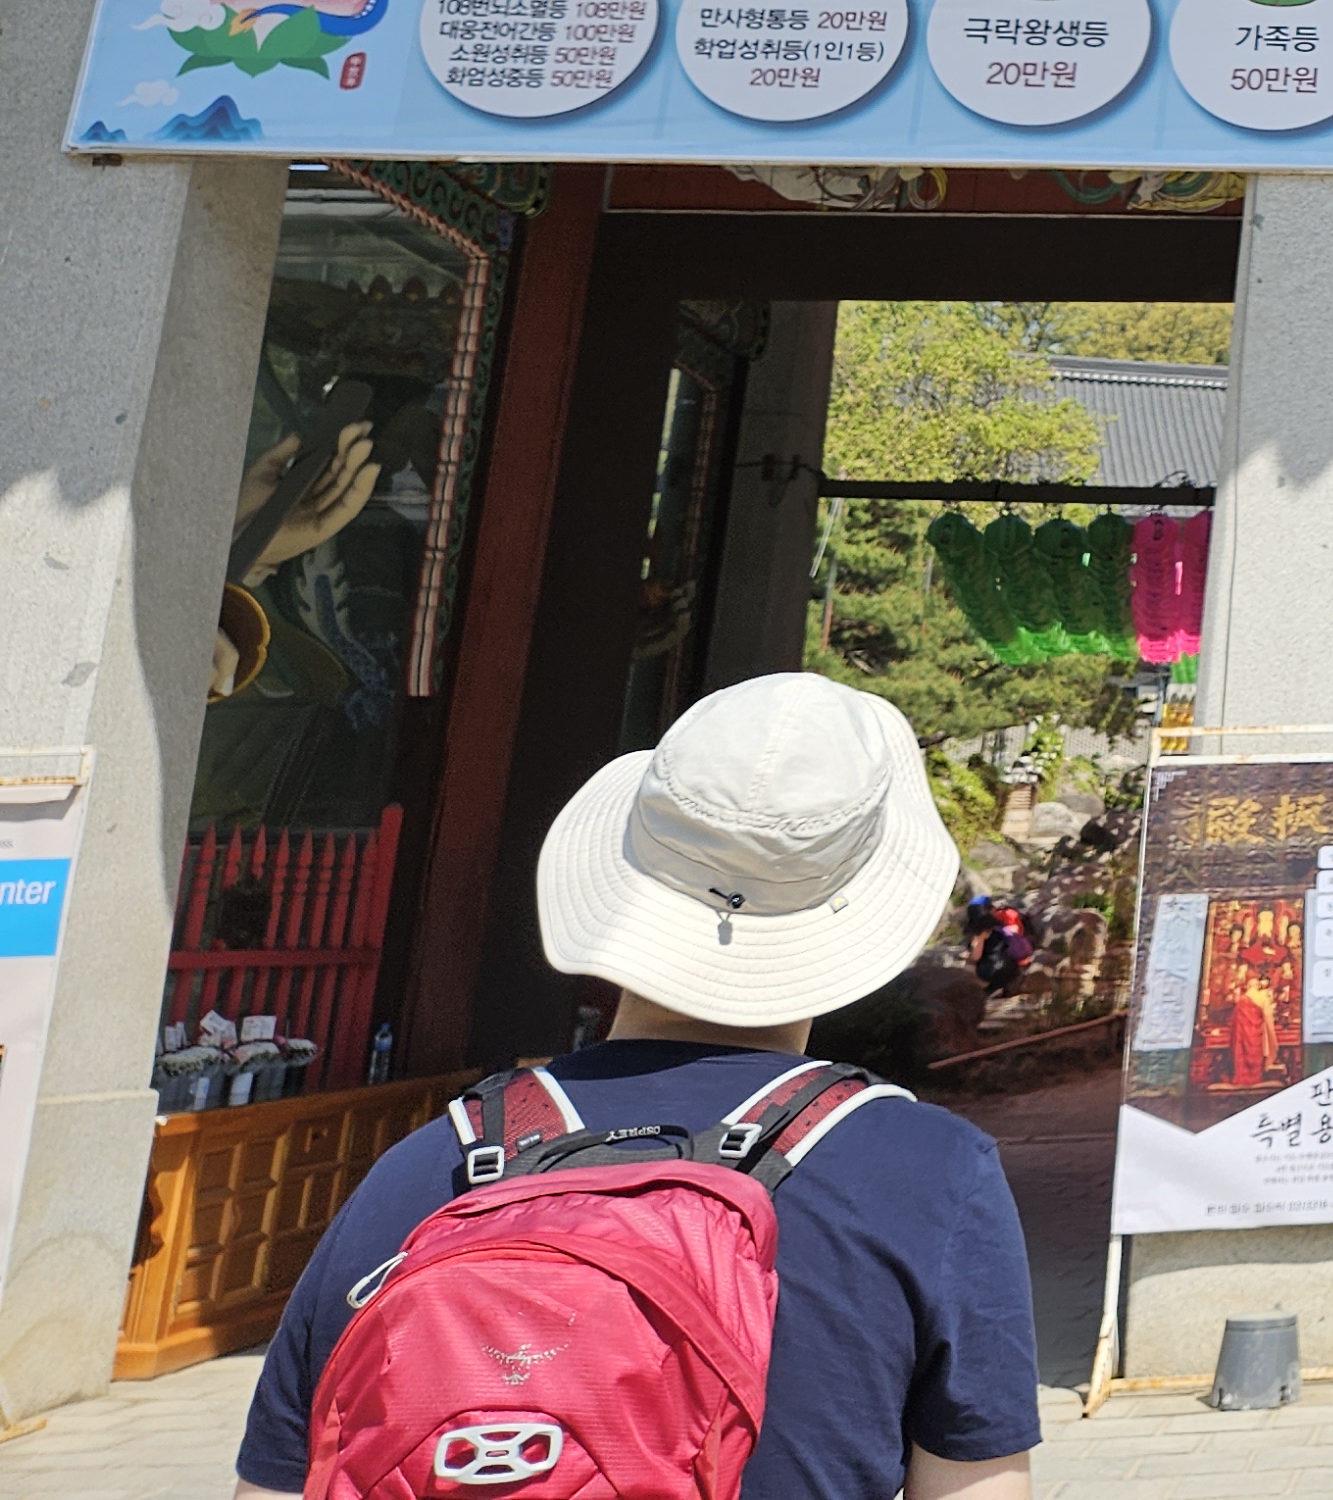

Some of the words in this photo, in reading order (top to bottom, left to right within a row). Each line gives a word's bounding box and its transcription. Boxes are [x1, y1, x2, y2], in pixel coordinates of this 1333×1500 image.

[576, 1, 648, 20] 108만원
[701, 8, 809, 30] 만사형통등
[817, 11, 887, 32] 20만원
[439, 20, 557, 42] 대웅전어간등
[565, 23, 637, 43] 100만원
[964, 18, 1108, 48] 극락왕생등
[1236, 24, 1319, 53] 가족등
[449, 43, 549, 65] 소원성취등
[555, 46, 616, 66] 50만원
[694, 38, 884, 61] 학업성취등(1인1등)
[446, 67, 544, 88] 화엄성중등
[551, 69, 613, 89] 50만원
[750, 68, 820, 88] 20만원
[986, 61, 1078, 89] 20만원
[1230, 66, 1319, 94] 50만원
[605, 1126, 660, 1142] OSPREY
[1250, 1112, 1302, 1149] 특별
